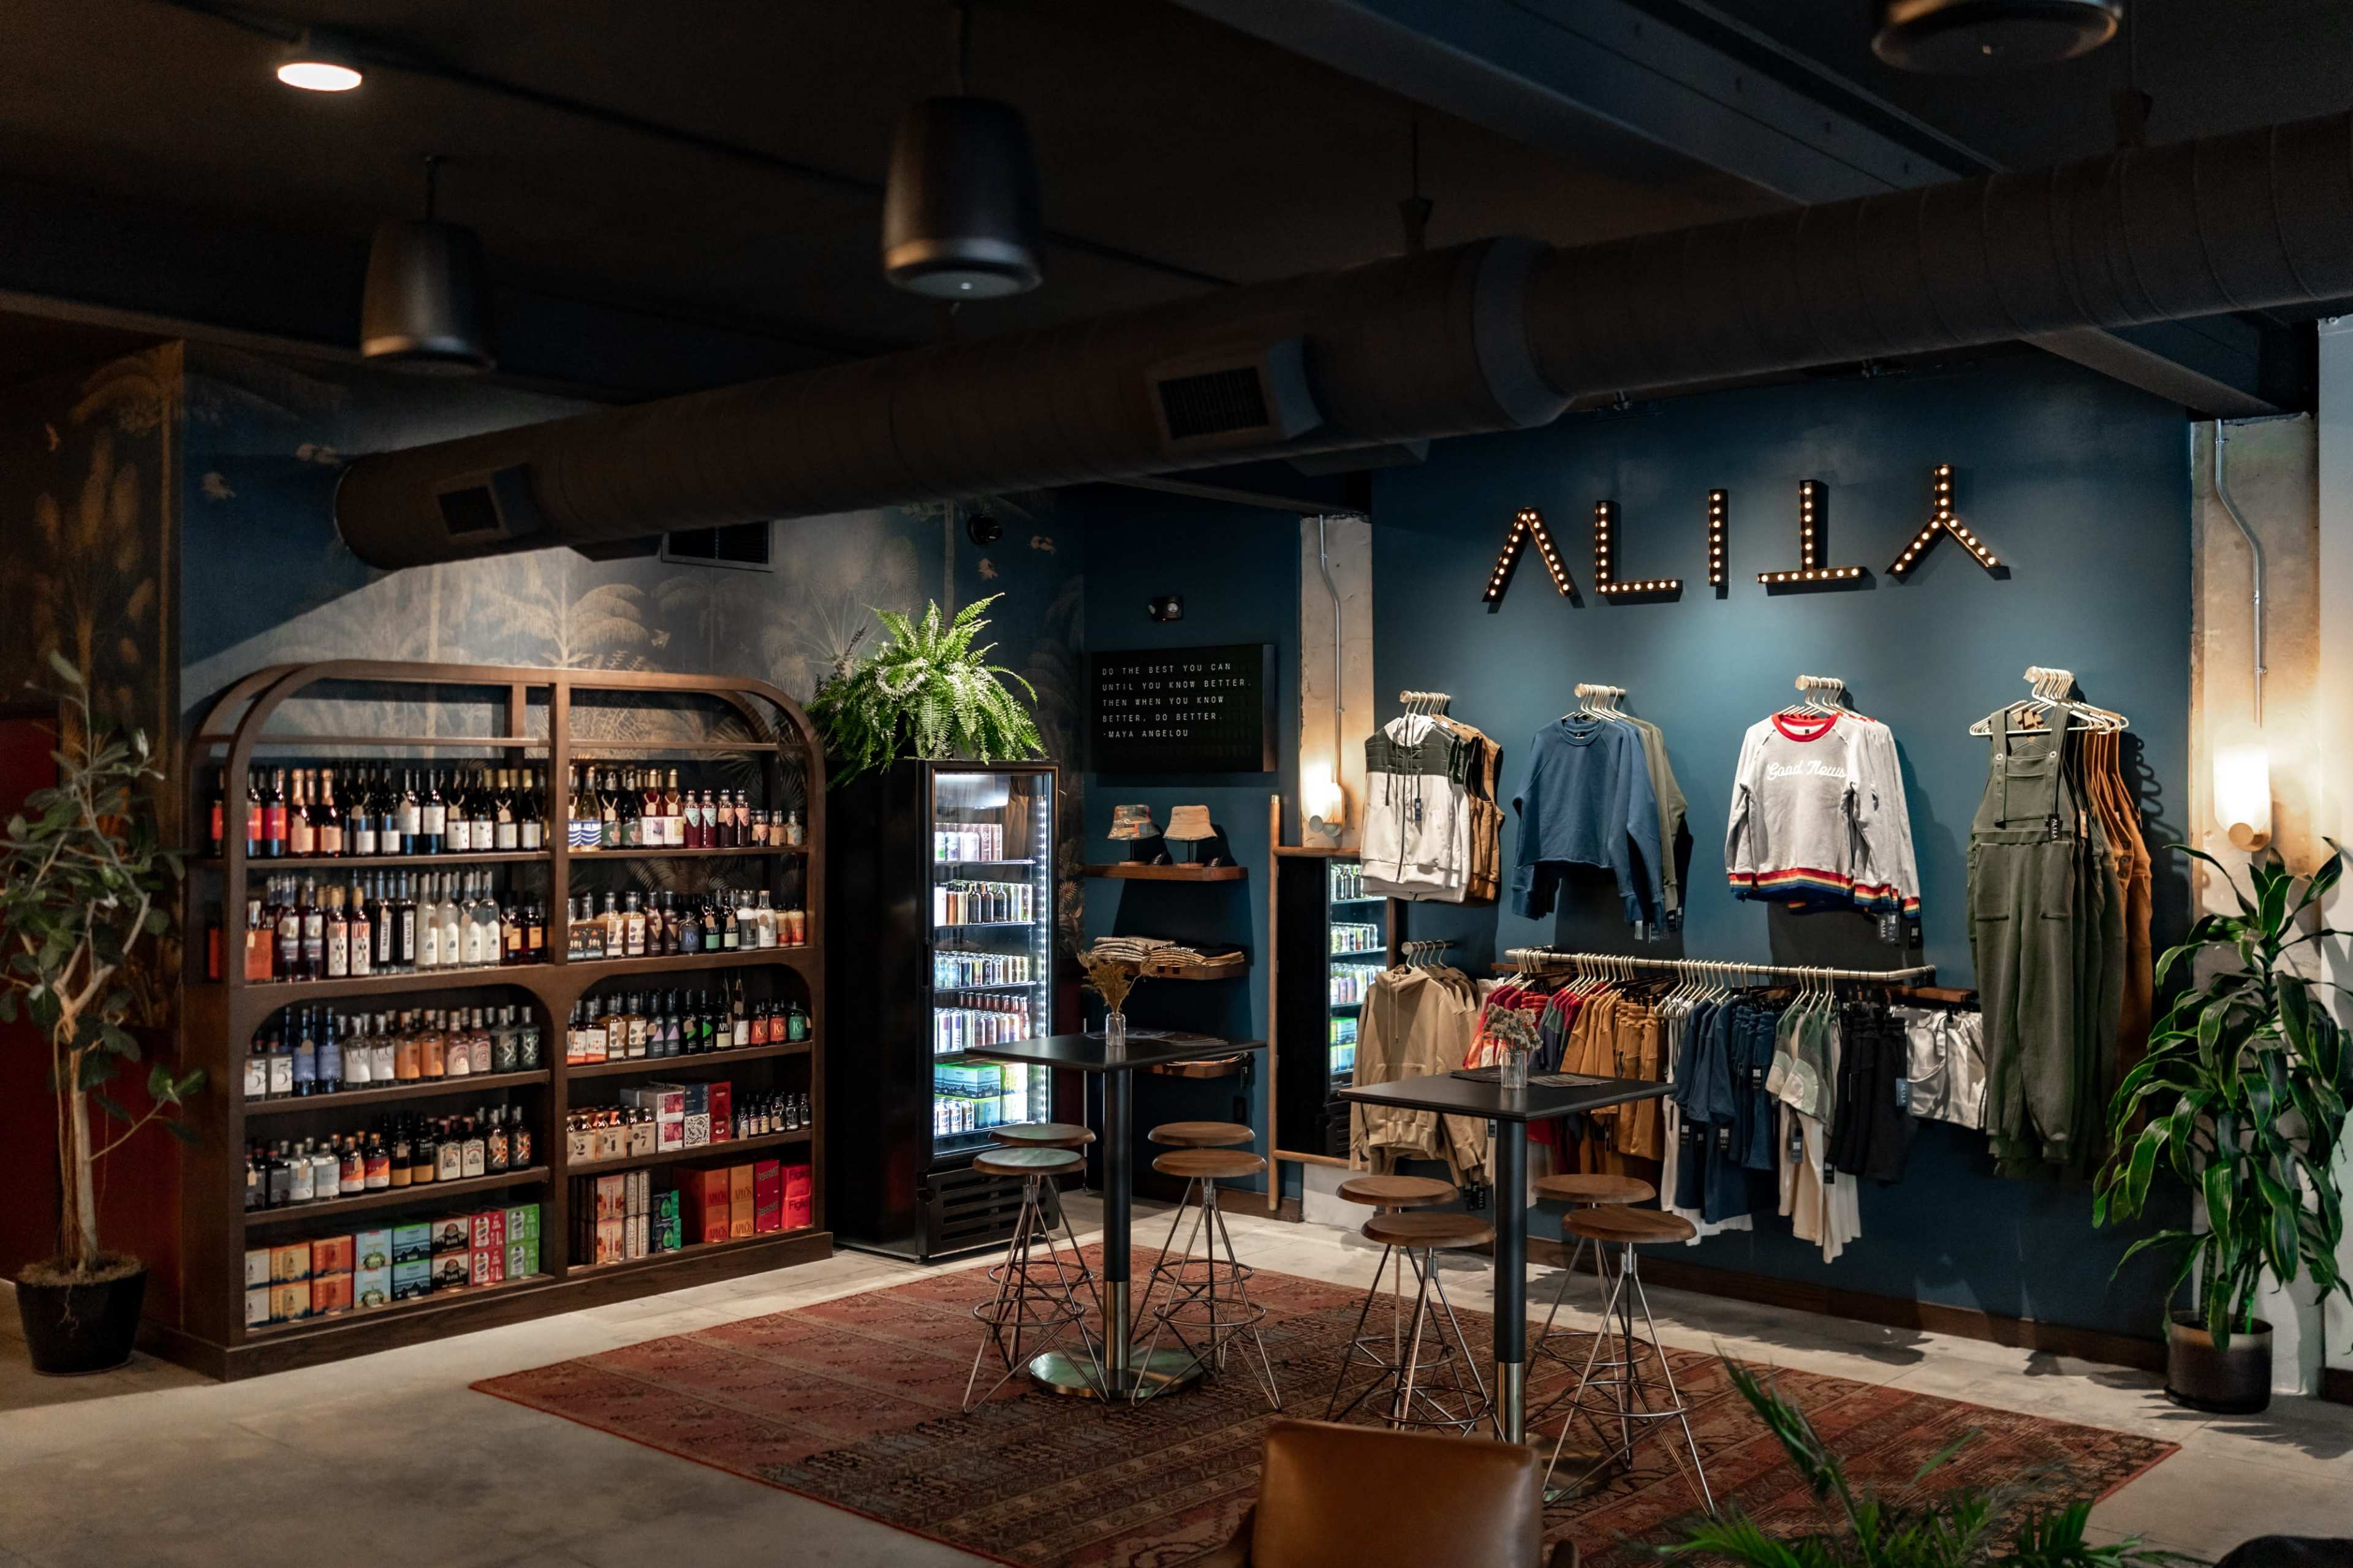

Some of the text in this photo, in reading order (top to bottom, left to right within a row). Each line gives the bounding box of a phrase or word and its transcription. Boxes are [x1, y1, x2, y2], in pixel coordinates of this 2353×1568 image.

[1148, 665, 1175, 674] BEST
[1204, 679, 1251, 687] BETTER.
[1142, 729, 1189, 738] ANGELOU
[1766, 759, 1847, 781] Good News
